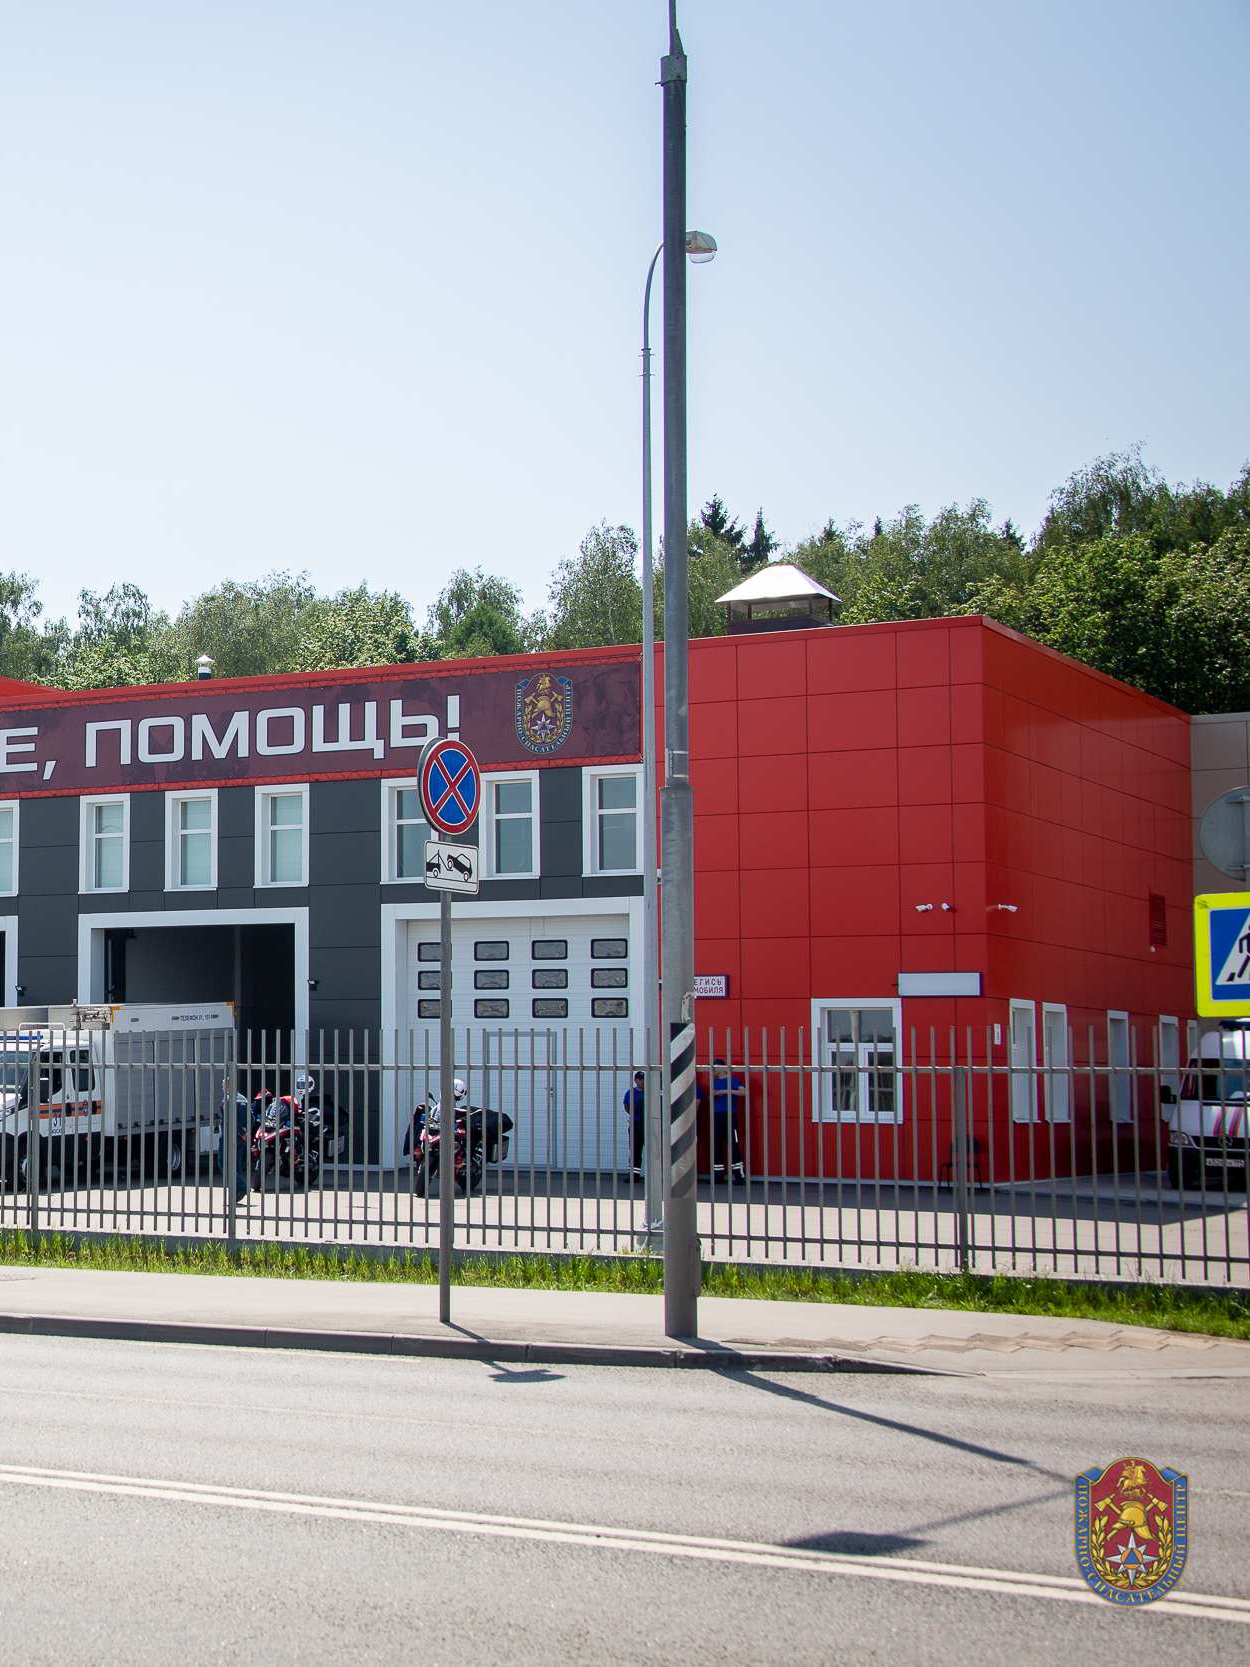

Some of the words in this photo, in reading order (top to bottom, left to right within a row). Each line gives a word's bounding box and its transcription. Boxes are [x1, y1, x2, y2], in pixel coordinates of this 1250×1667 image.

[85, 694, 461, 768] ПОМОЩЬ!
[694, 978, 722, 986] ЕГИСЬ
[694, 986, 724, 994] МОБИЛЯ
